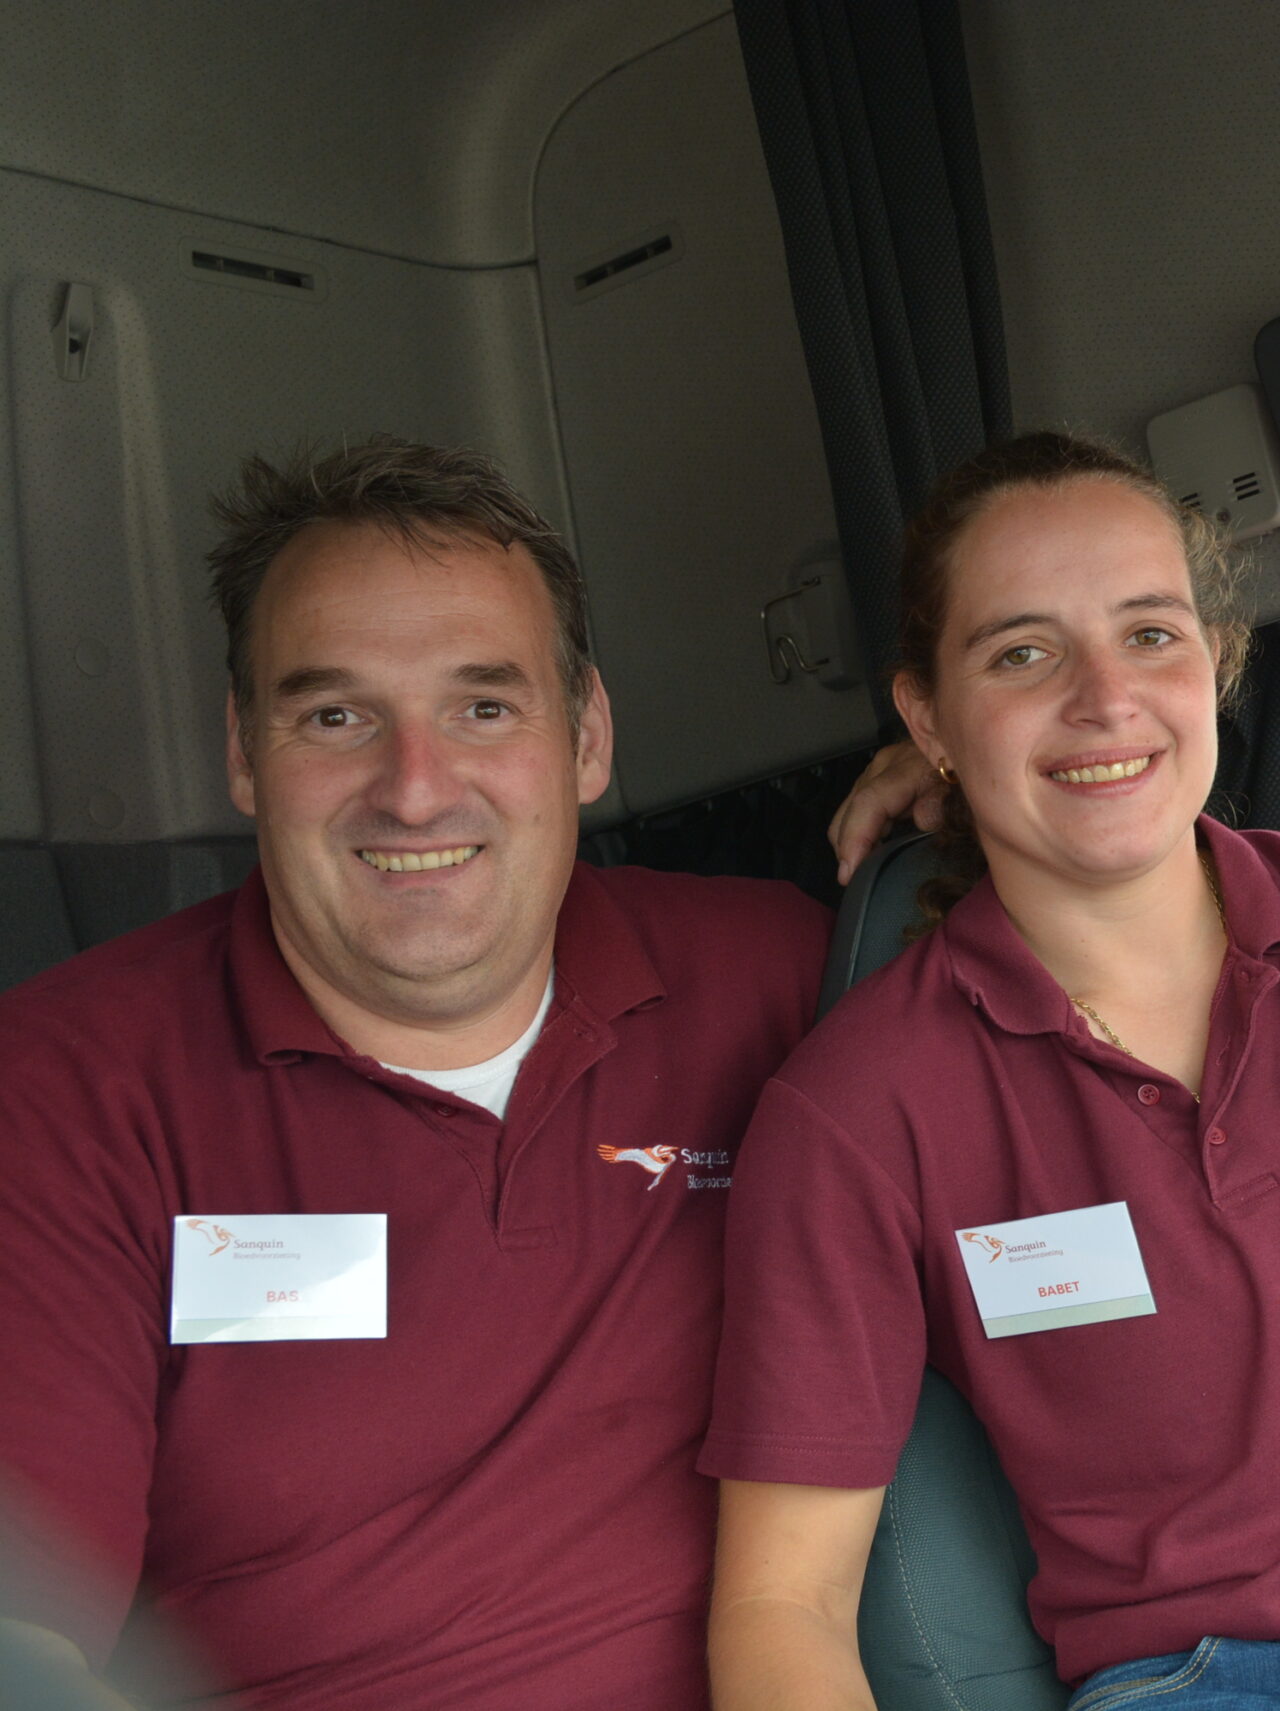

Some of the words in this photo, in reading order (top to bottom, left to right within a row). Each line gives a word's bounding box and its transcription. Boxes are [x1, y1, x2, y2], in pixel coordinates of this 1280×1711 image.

[233, 1238, 285, 1251] Sanquin
[1005, 1240, 1047, 1254] Sanquin
[1038, 1281, 1081, 1298] BABET
[265, 1290, 300, 1303] BAS
